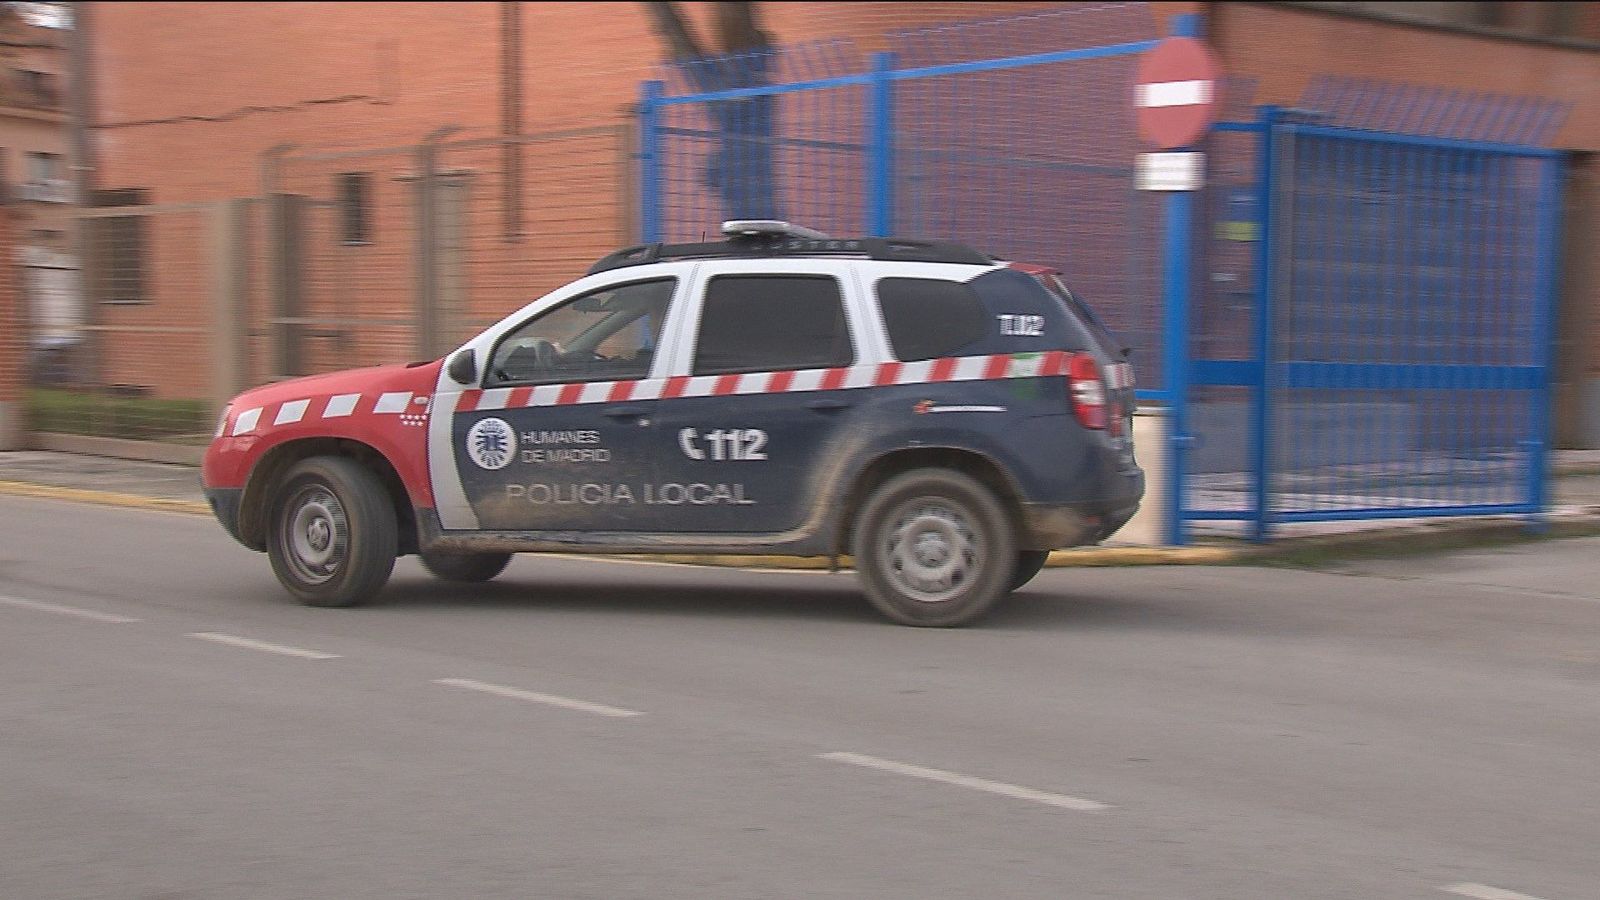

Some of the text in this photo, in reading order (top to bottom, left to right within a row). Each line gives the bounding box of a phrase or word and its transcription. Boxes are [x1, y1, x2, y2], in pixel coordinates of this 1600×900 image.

[520, 430, 600, 444] HUMANES
[704, 428, 768, 461] 112
[521, 449, 611, 463] DE MADRID
[506, 483, 757, 505] POLICIA LOCAL
